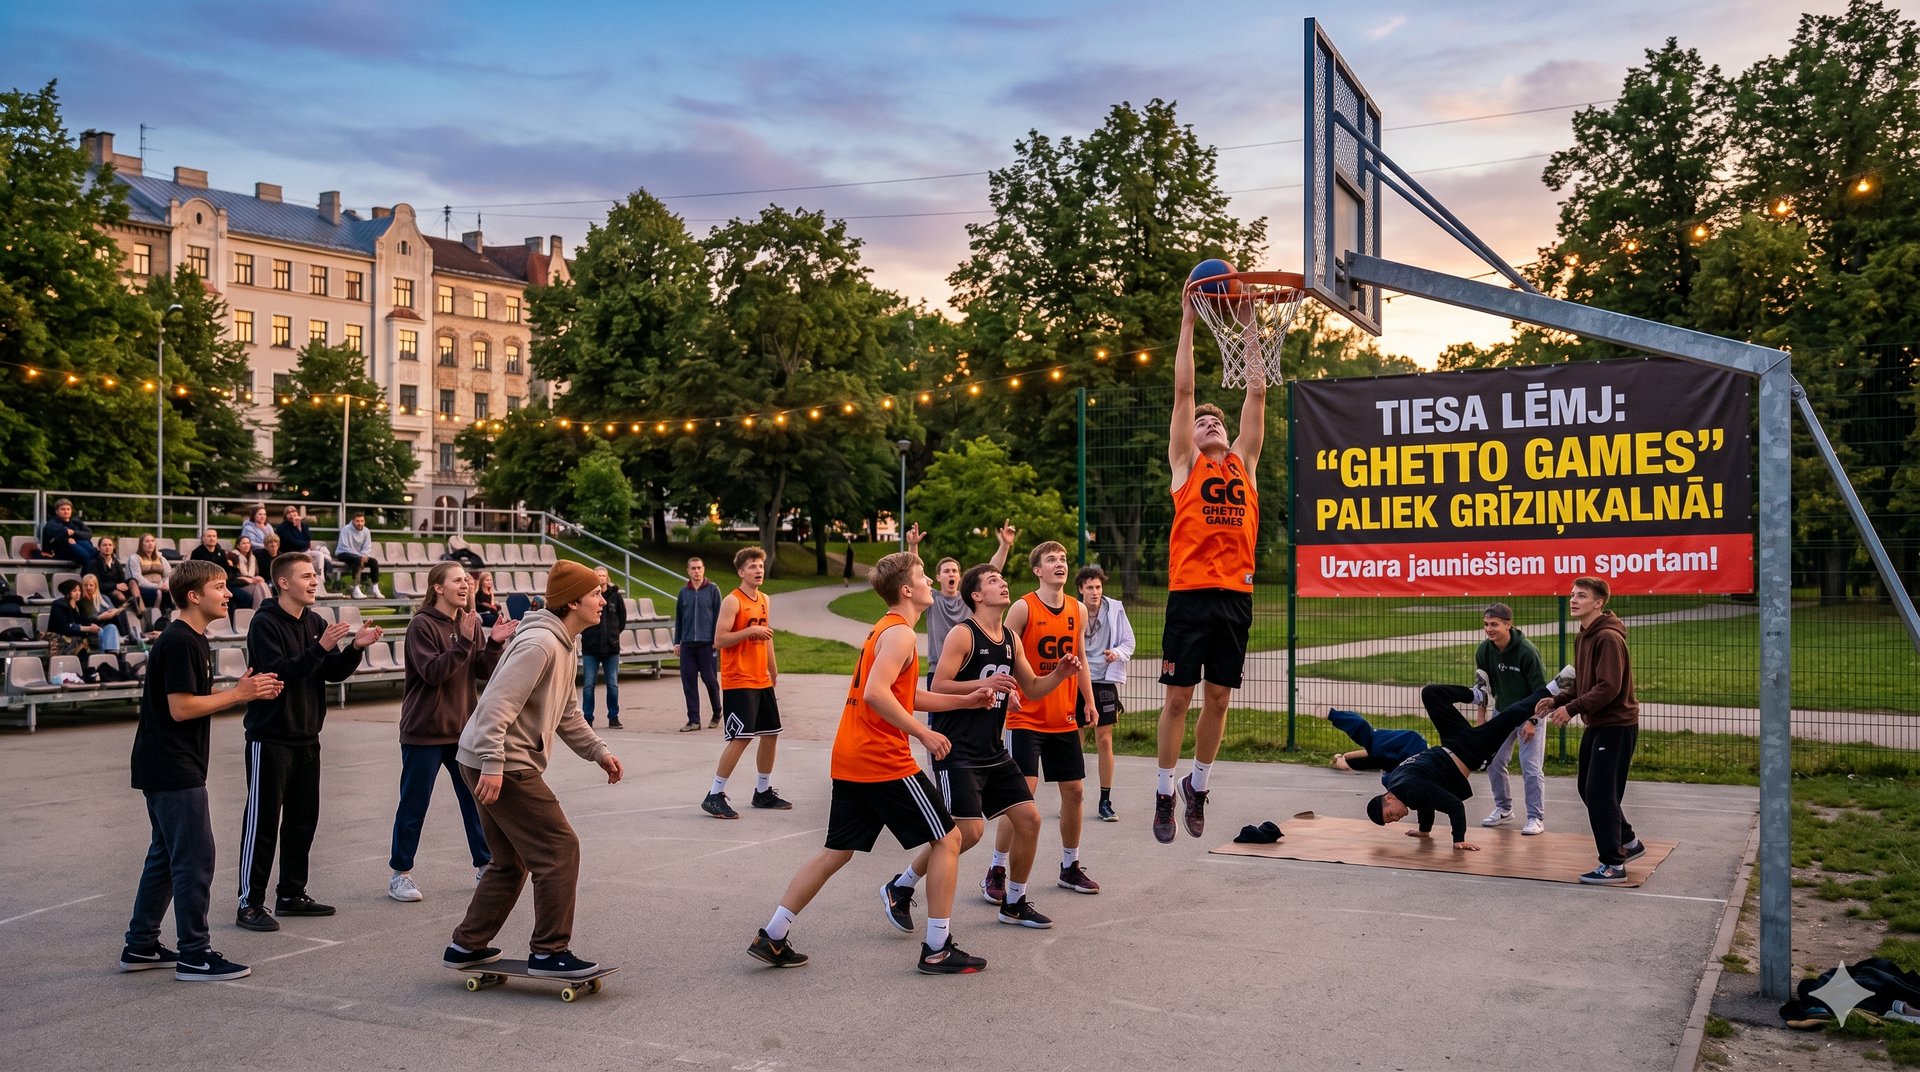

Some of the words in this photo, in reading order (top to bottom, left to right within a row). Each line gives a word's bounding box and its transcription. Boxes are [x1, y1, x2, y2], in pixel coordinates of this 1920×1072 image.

[1375, 394, 1489, 436] TIESA
[1501, 382, 1626, 429] LĒMJ:
[1201, 477, 1246, 506] GG
[1202, 506, 1245, 517] GHETTO
[1316, 493, 1439, 531] PALIEK
[1450, 476, 1724, 535] GRĪZIŅKALNĀ!
[1205, 516, 1243, 527] GAMES
[1320, 555, 1401, 579] Uzvara
[1407, 551, 1545, 583] jauniešiem
[1553, 555, 1586, 575] un
[1594, 546, 1718, 578] sportam!
[1067, 616, 1075, 631] 9
[1037, 635, 1074, 660] GG
